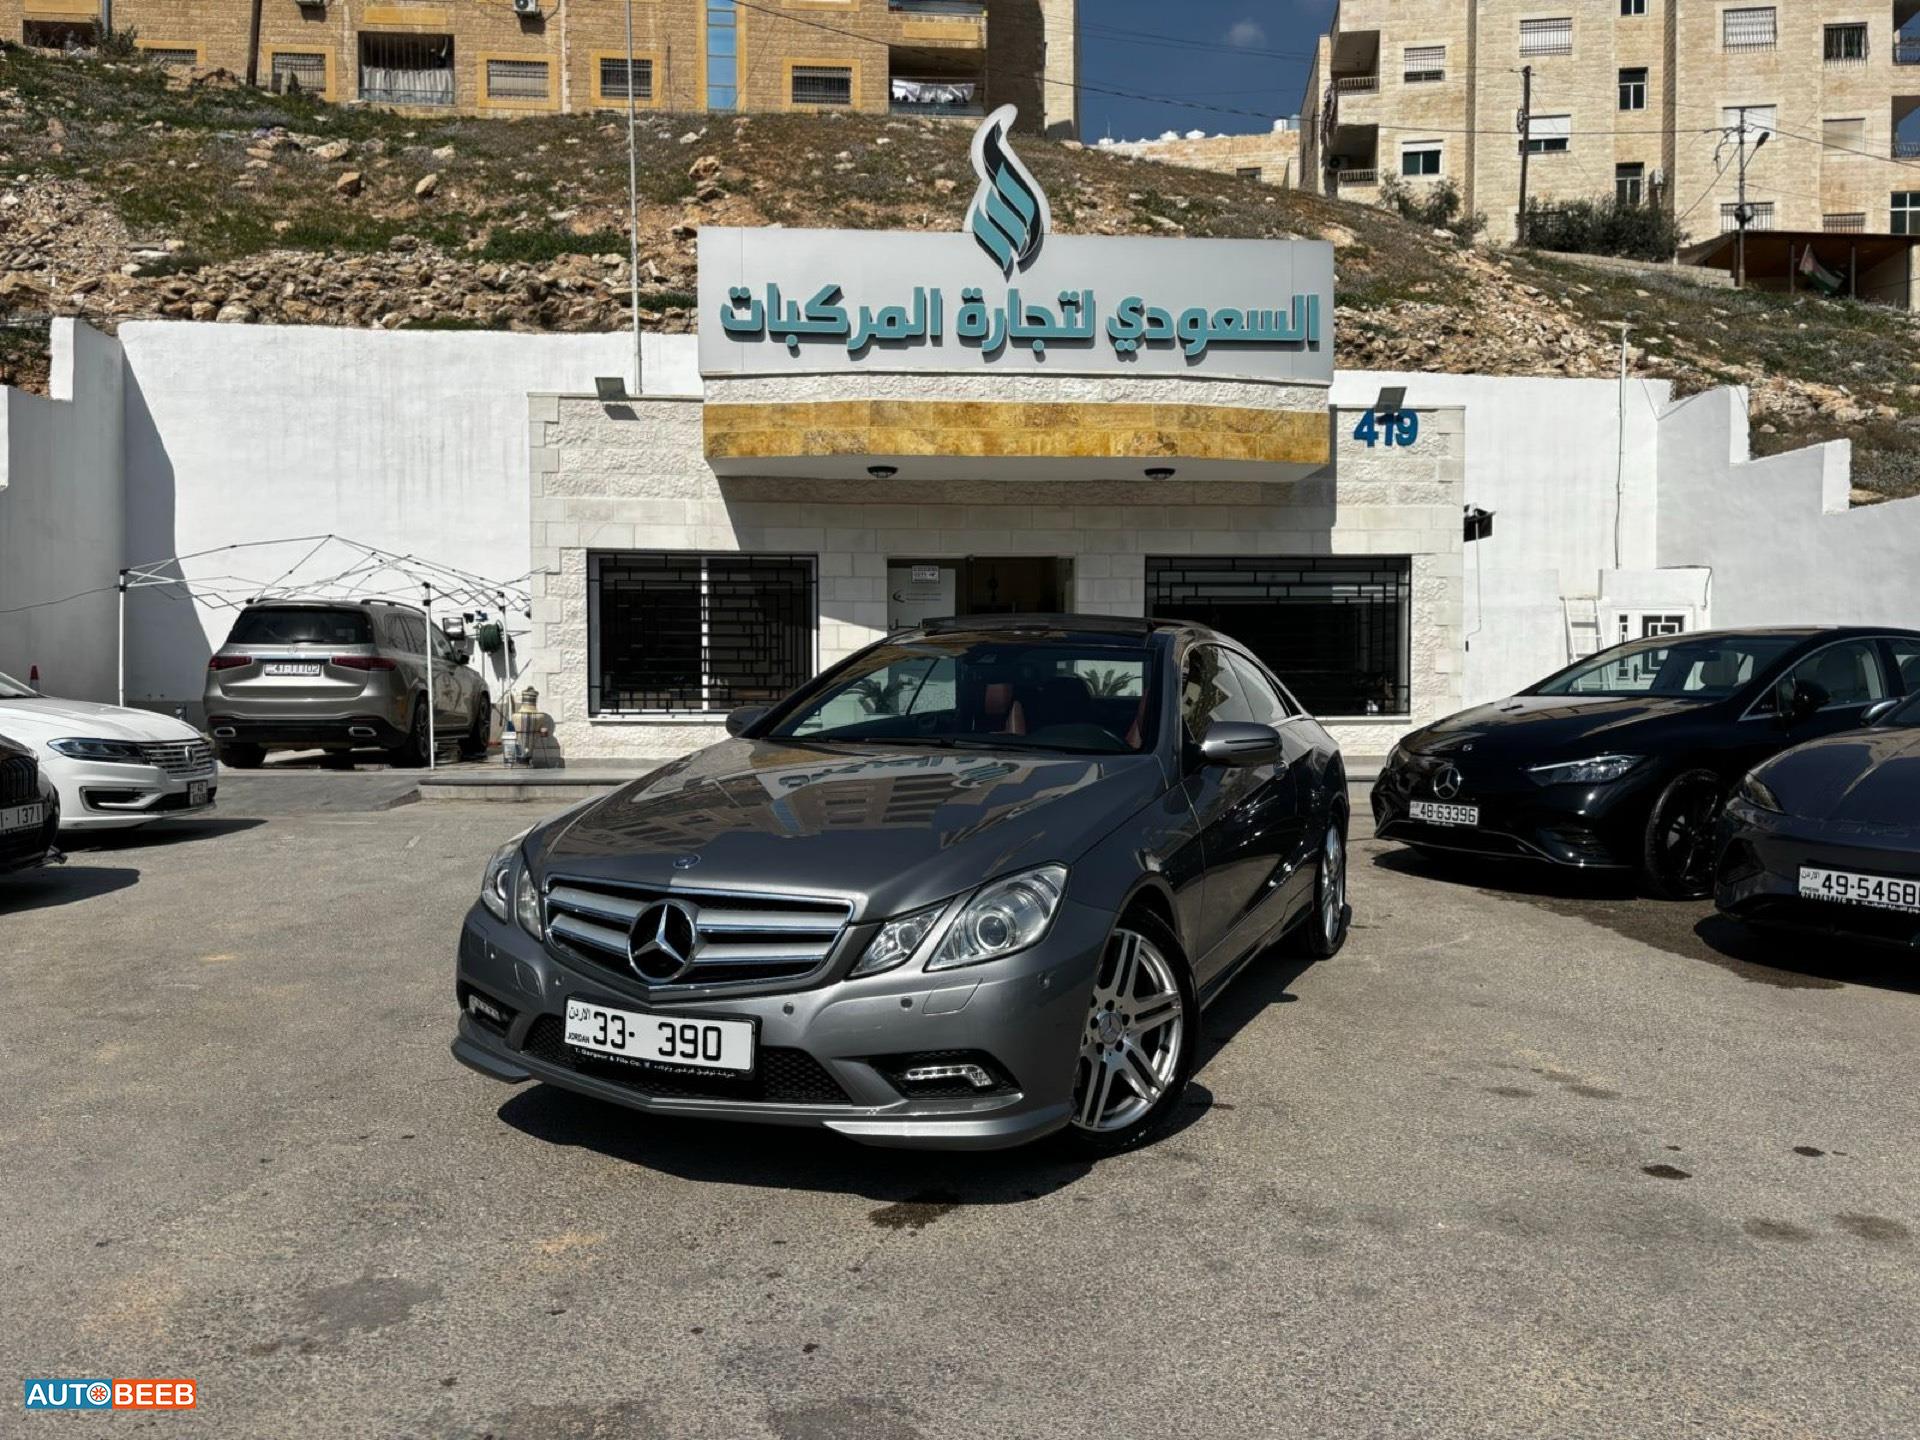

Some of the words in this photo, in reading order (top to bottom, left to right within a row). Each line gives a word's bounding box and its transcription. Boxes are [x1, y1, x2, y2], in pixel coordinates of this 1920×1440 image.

[720, 282, 943, 351] المركبات
[956, 287, 1095, 353] لتجارة
[1107, 293, 1320, 356] السعودي
[1353, 407, 1418, 447] 419
[1420, 803, 1476, 823] 48-63396
[1821, 873, 1920, 905] 49-5468
[568, 1032, 590, 1044] JORDAN
[657, 1021, 722, 1062] 390
